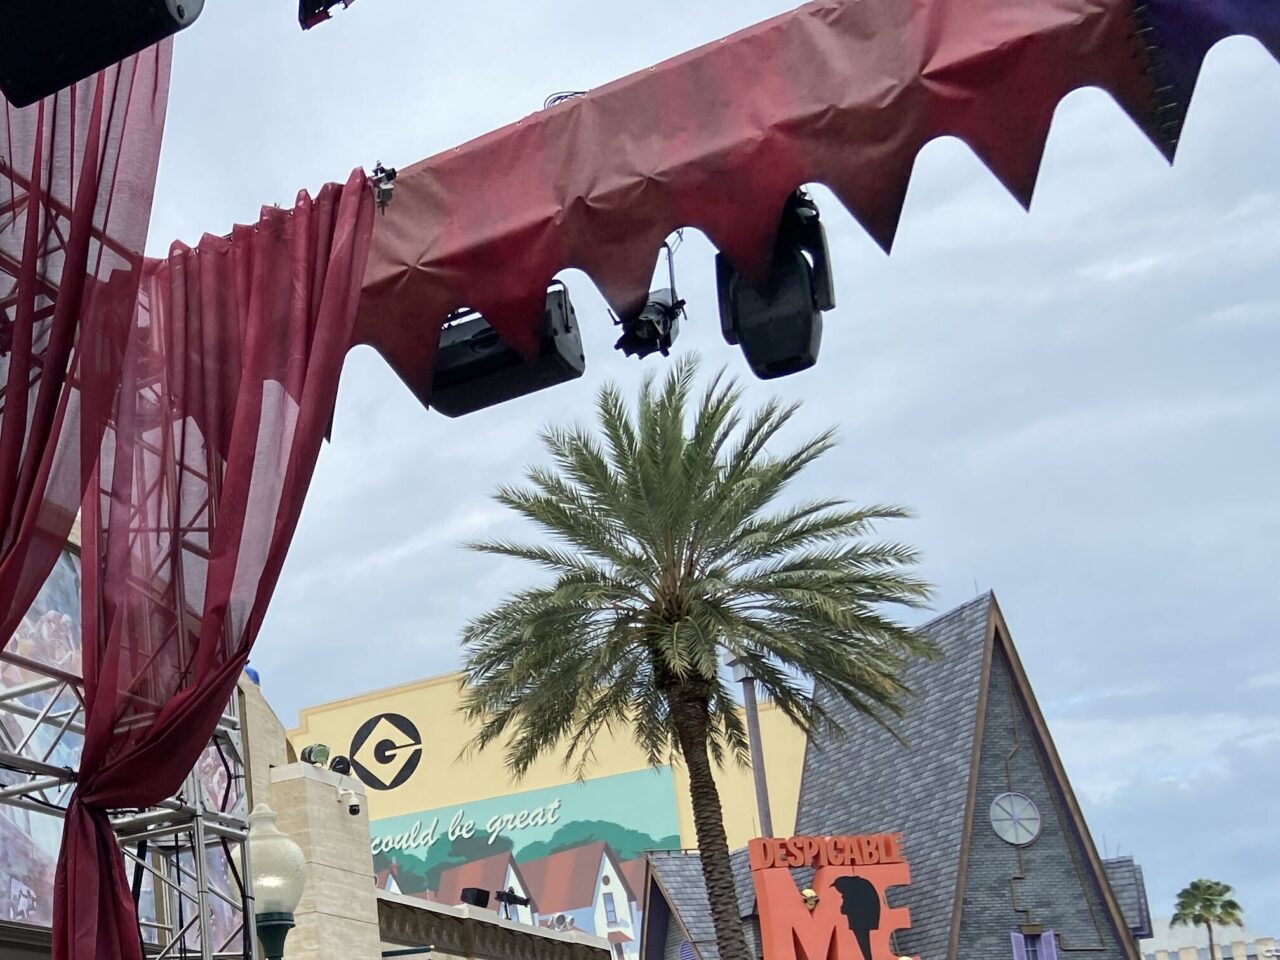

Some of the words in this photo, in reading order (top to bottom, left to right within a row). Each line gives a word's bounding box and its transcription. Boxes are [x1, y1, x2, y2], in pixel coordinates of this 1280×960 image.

[370, 816, 440, 856] could
[447, 809, 476, 842] be
[486, 798, 562, 846] great
[760, 833, 907, 868] DESPICABLE
